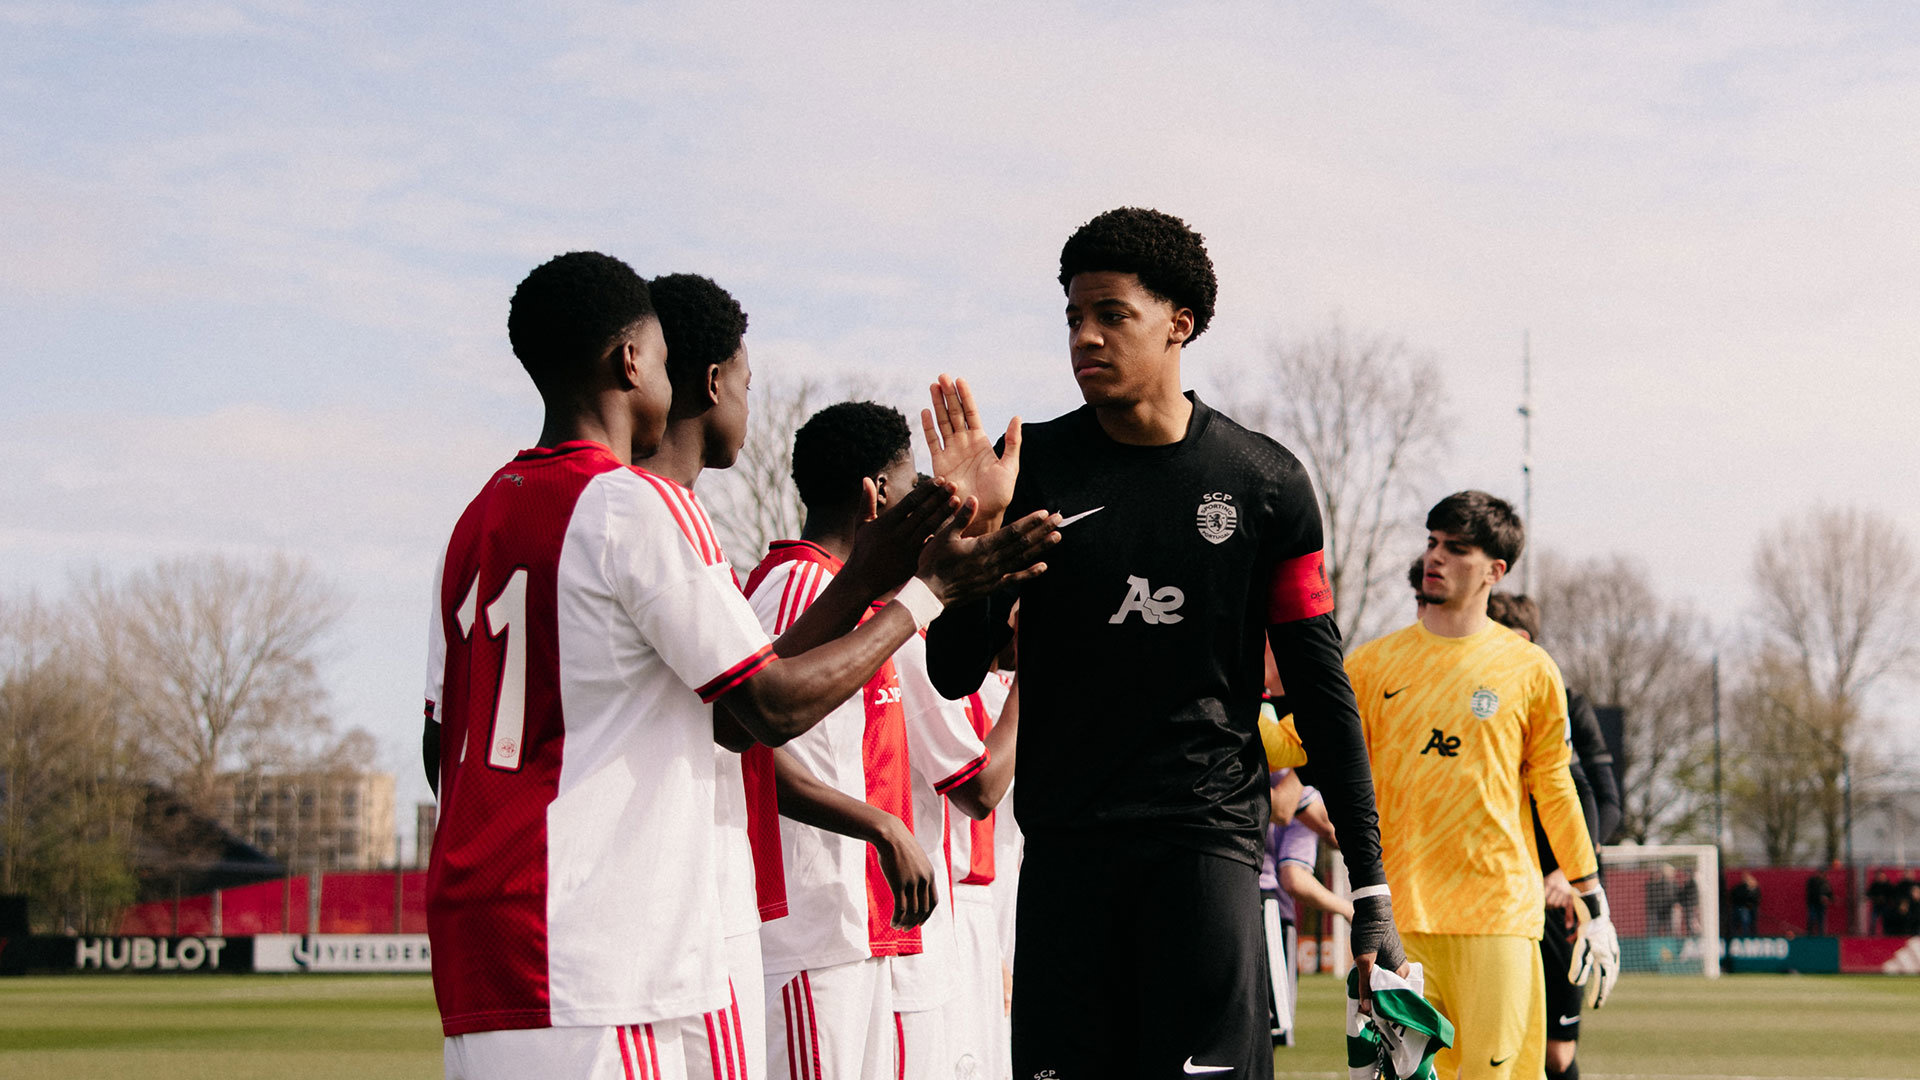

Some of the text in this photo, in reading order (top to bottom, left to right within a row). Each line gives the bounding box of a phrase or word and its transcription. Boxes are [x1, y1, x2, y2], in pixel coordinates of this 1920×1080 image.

[1202, 492, 1233, 502] SCP
[75, 937, 227, 970] HUBLOT
[1033, 1069, 1056, 1080] SCP
